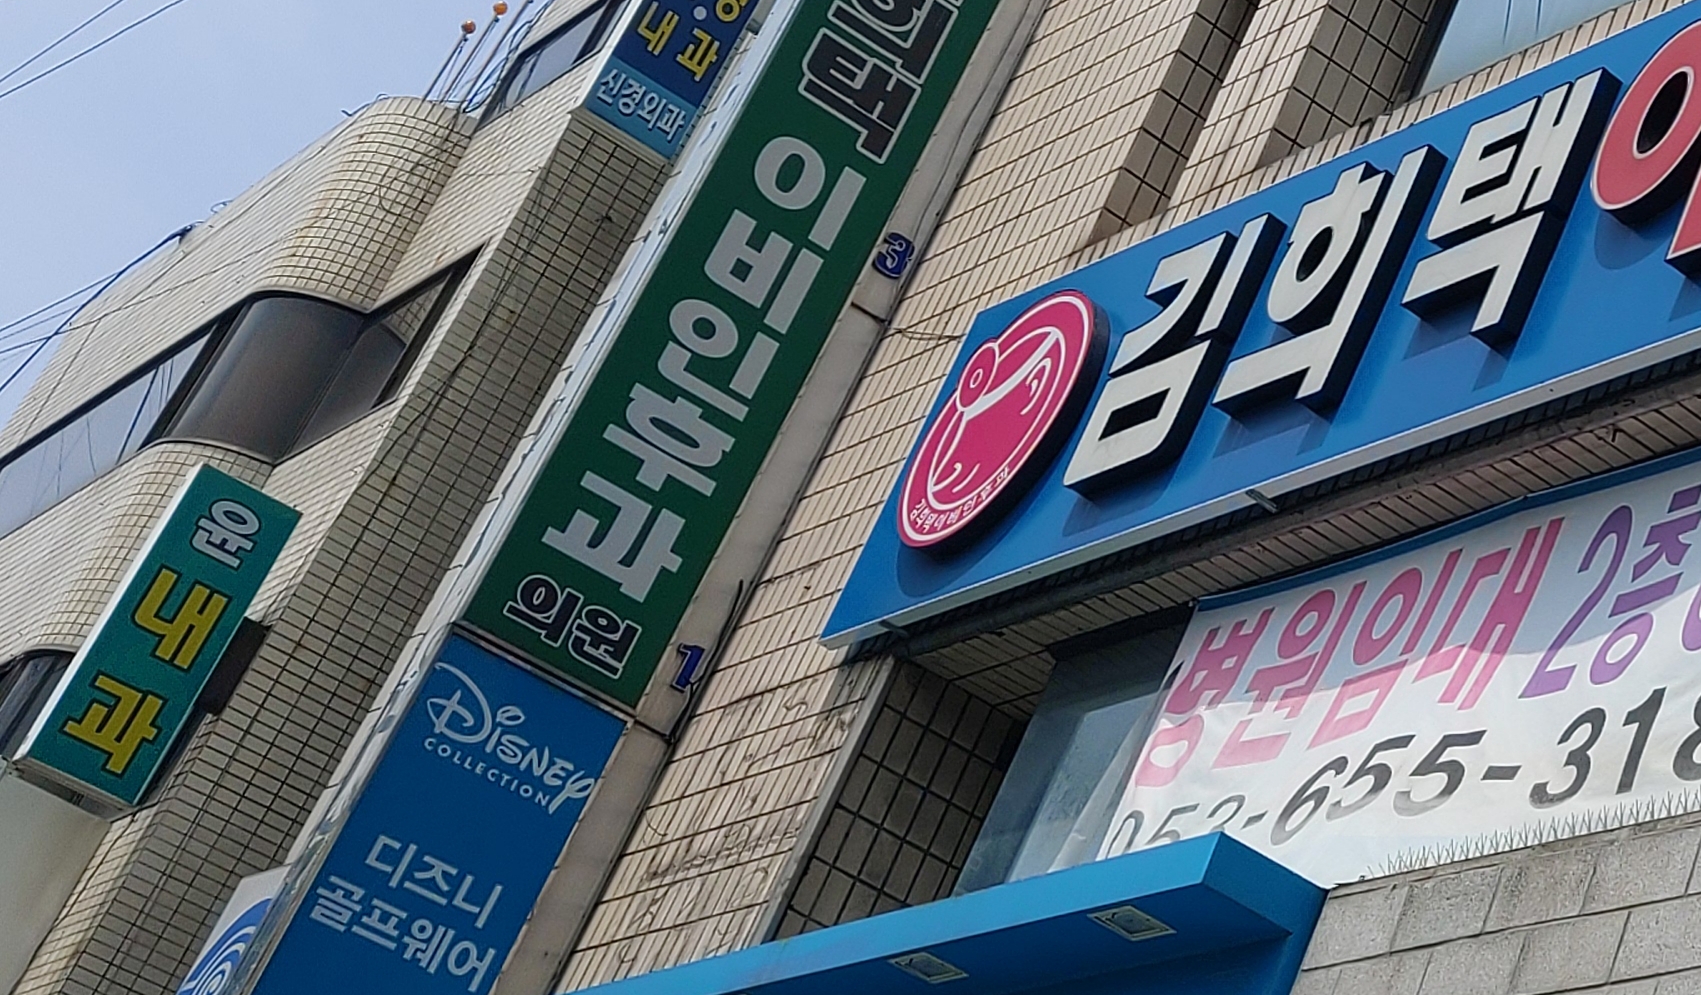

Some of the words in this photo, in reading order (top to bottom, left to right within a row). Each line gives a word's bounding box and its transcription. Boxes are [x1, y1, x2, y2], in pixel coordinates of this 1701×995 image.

[596, 68, 688, 141] 신경외과
[503, 573, 642, 680] 의원
[424, 737, 550, 807] COLLECTION
[364, 833, 503, 930] 디즈니
[309, 875, 497, 993] 골프웨어
